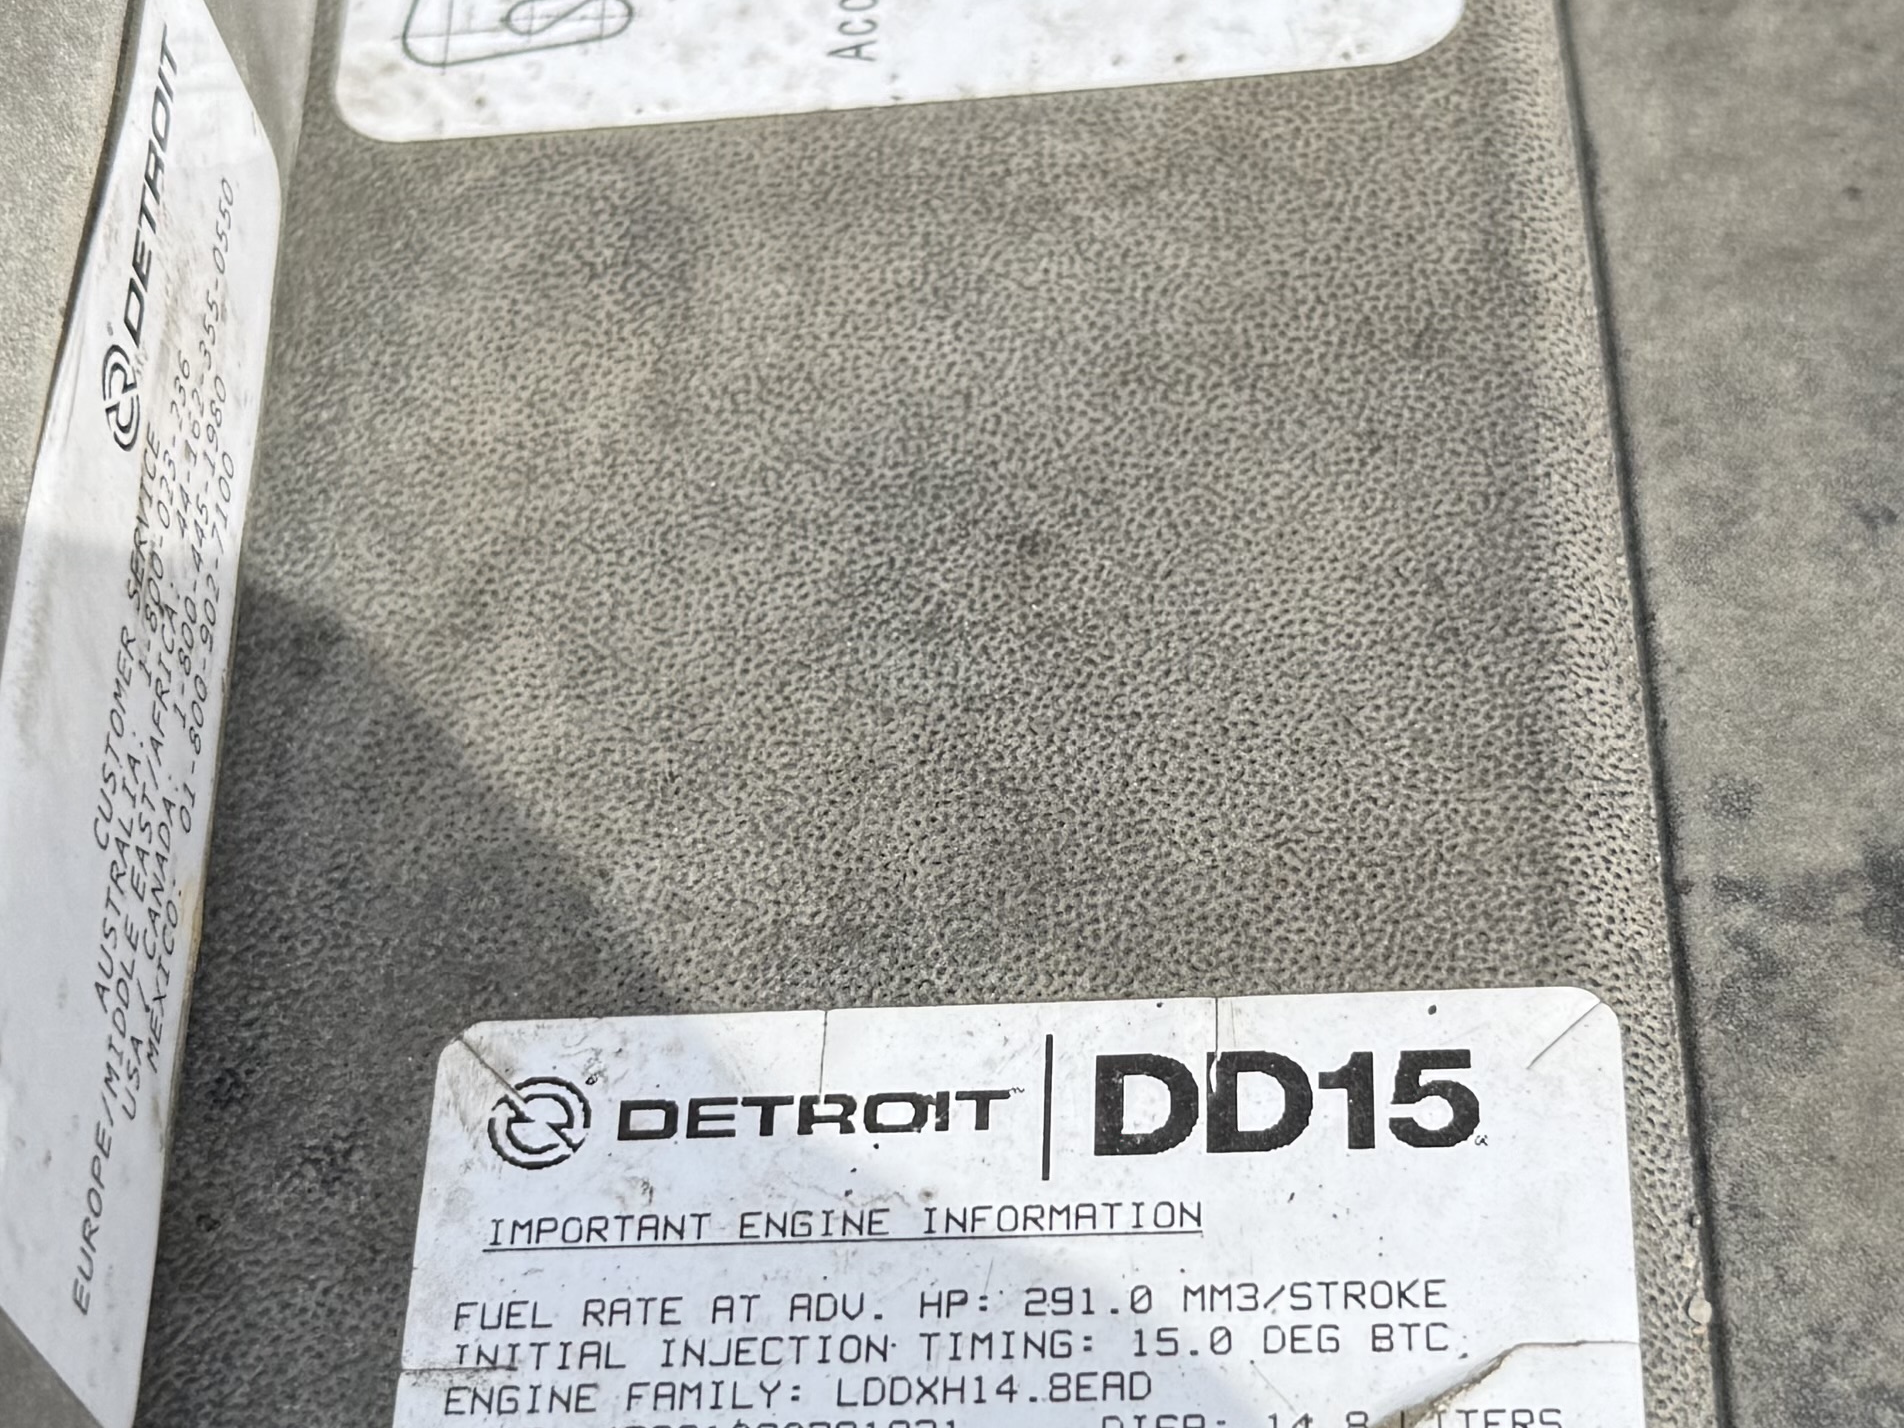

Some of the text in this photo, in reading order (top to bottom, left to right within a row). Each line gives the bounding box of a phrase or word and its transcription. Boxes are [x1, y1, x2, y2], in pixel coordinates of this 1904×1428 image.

[121, 19, 181, 351] DETROIT
[90, 419, 162, 858] CUSTOMER SERVICE
[70, 909, 140, 1321] EUROPE/MIDDLE
[128, 570, 182, 905] EAST/AFRICA:
[91, 719, 145, 1017] AUSTRALIA:
[119, 1023, 146, 1128] USA
[140, 766, 180, 968] CANADA:
[143, 871, 183, 1078] MEXICO:
[616, 1048, 1481, 1157] DETROIT DD15
[452, 1277, 1448, 1330] FUEL RATE AT ADV. HP: 291.0 MM3/STROKE
[488, 1199, 1203, 1245] IMPORTANT ENGINE INFORMATION
[442, 1369, 1153, 1416] ENGINE FAMILY: LDDXH14.8EAD
[918, 1328, 1094, 1363] TIMING:
[1133, 1325, 1233, 1358] 15.0
[1265, 1322, 1341, 1356] DEG
